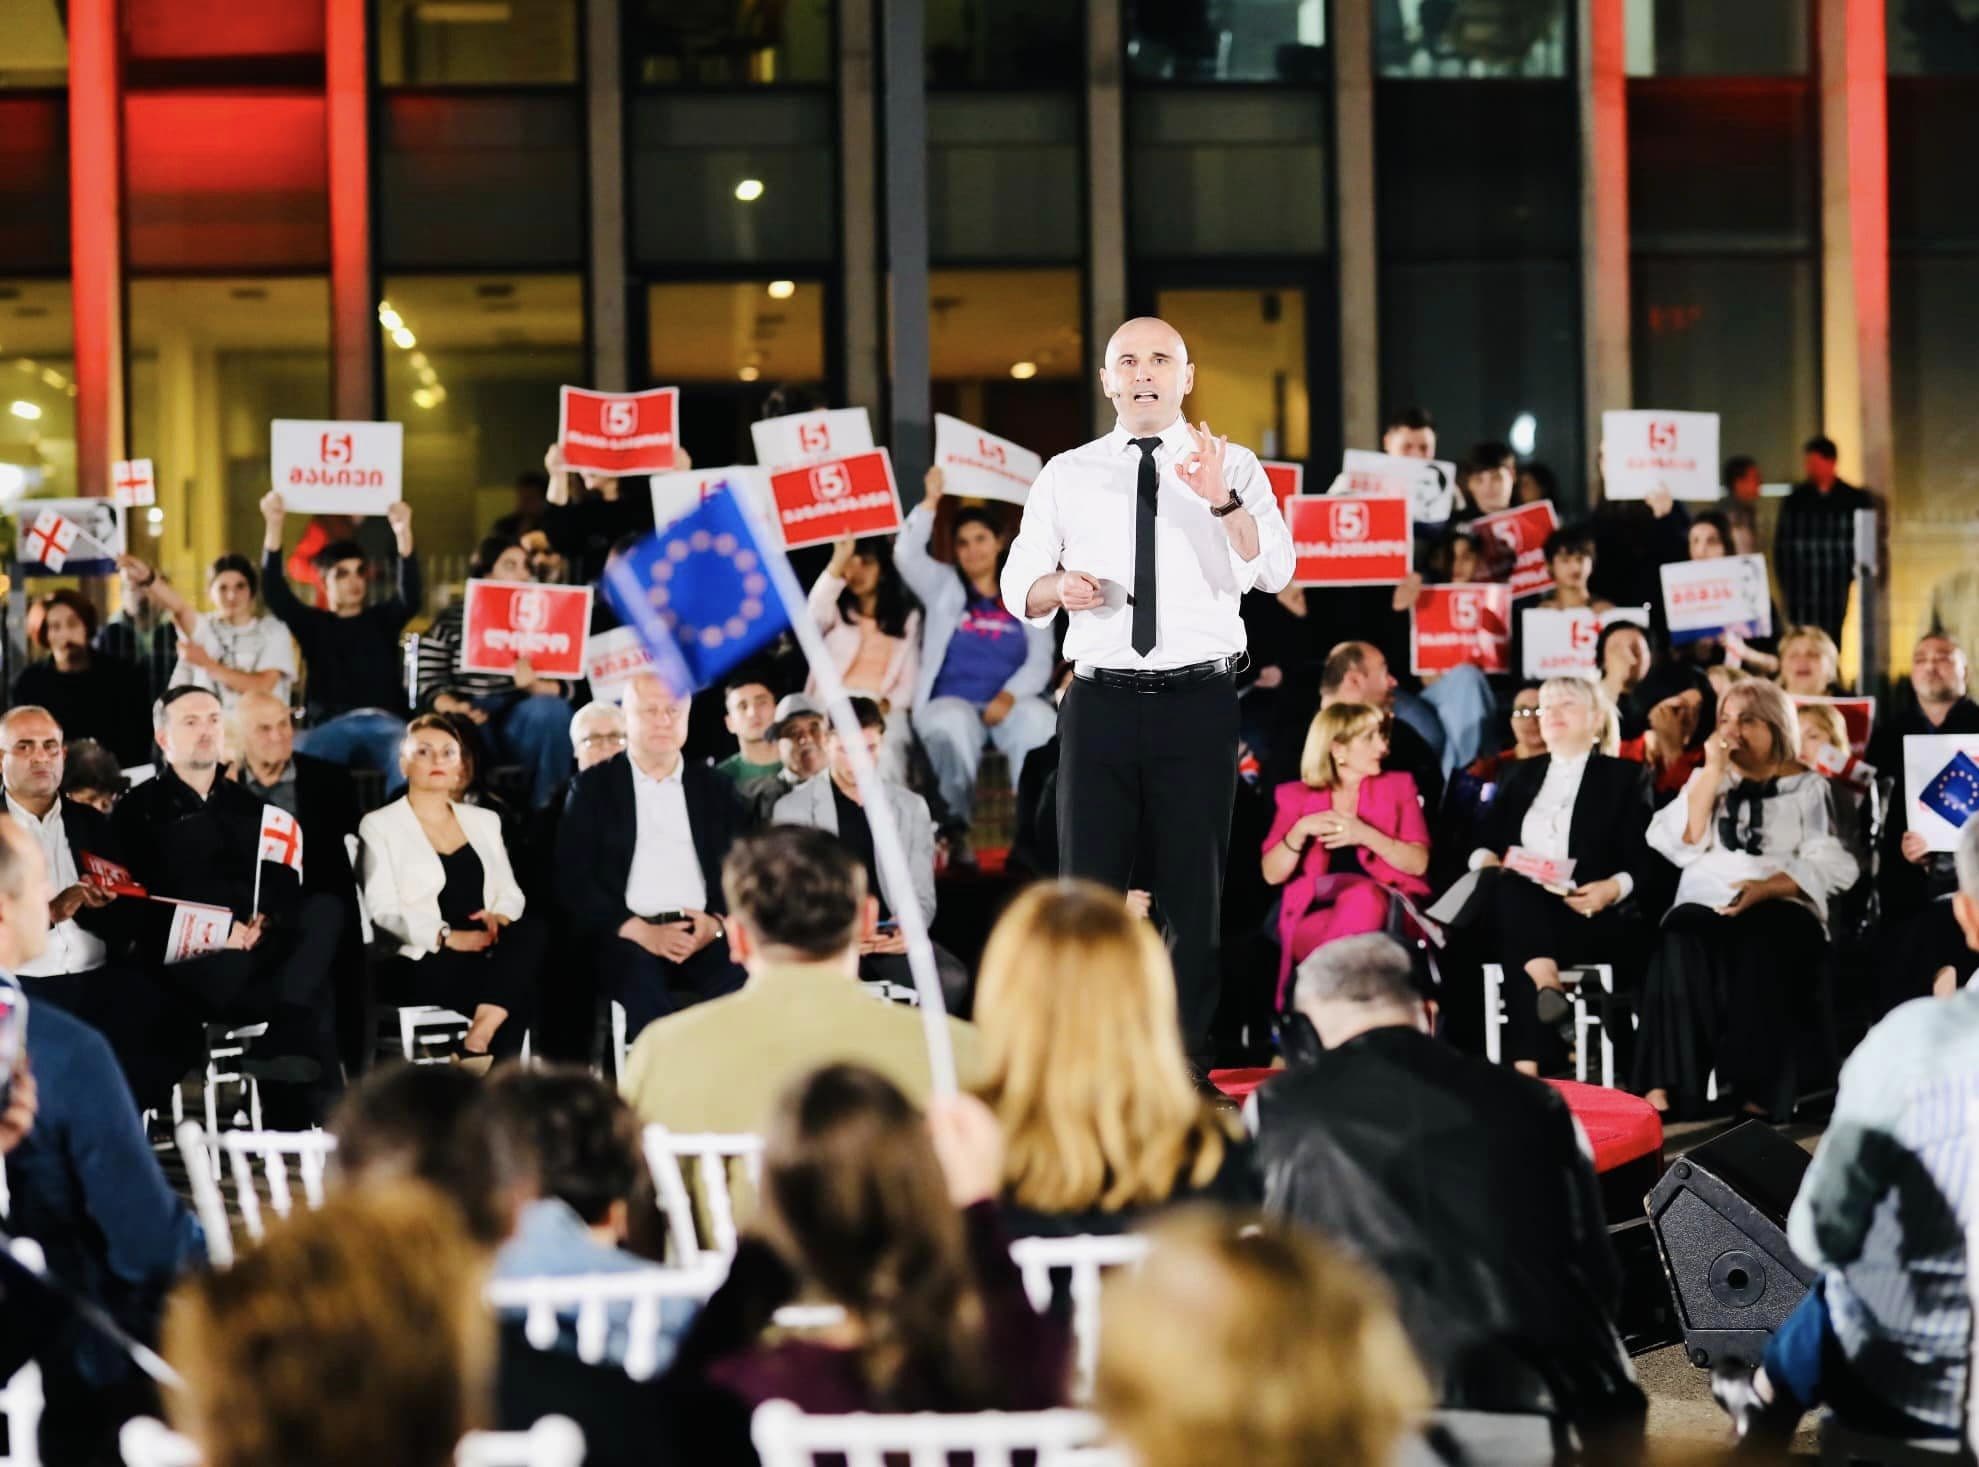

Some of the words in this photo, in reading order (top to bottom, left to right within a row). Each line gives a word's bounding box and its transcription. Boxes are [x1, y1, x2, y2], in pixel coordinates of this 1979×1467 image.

[607, 401, 634, 436] 5
[321, 432, 352, 464] 5
[800, 423, 830, 453] 5
[289, 467, 384, 487] მასივი
[817, 463, 845, 499] 5
[1337, 503, 1363, 539] 5
[518, 591, 544, 629] 5
[1455, 591, 1479, 628] 5
